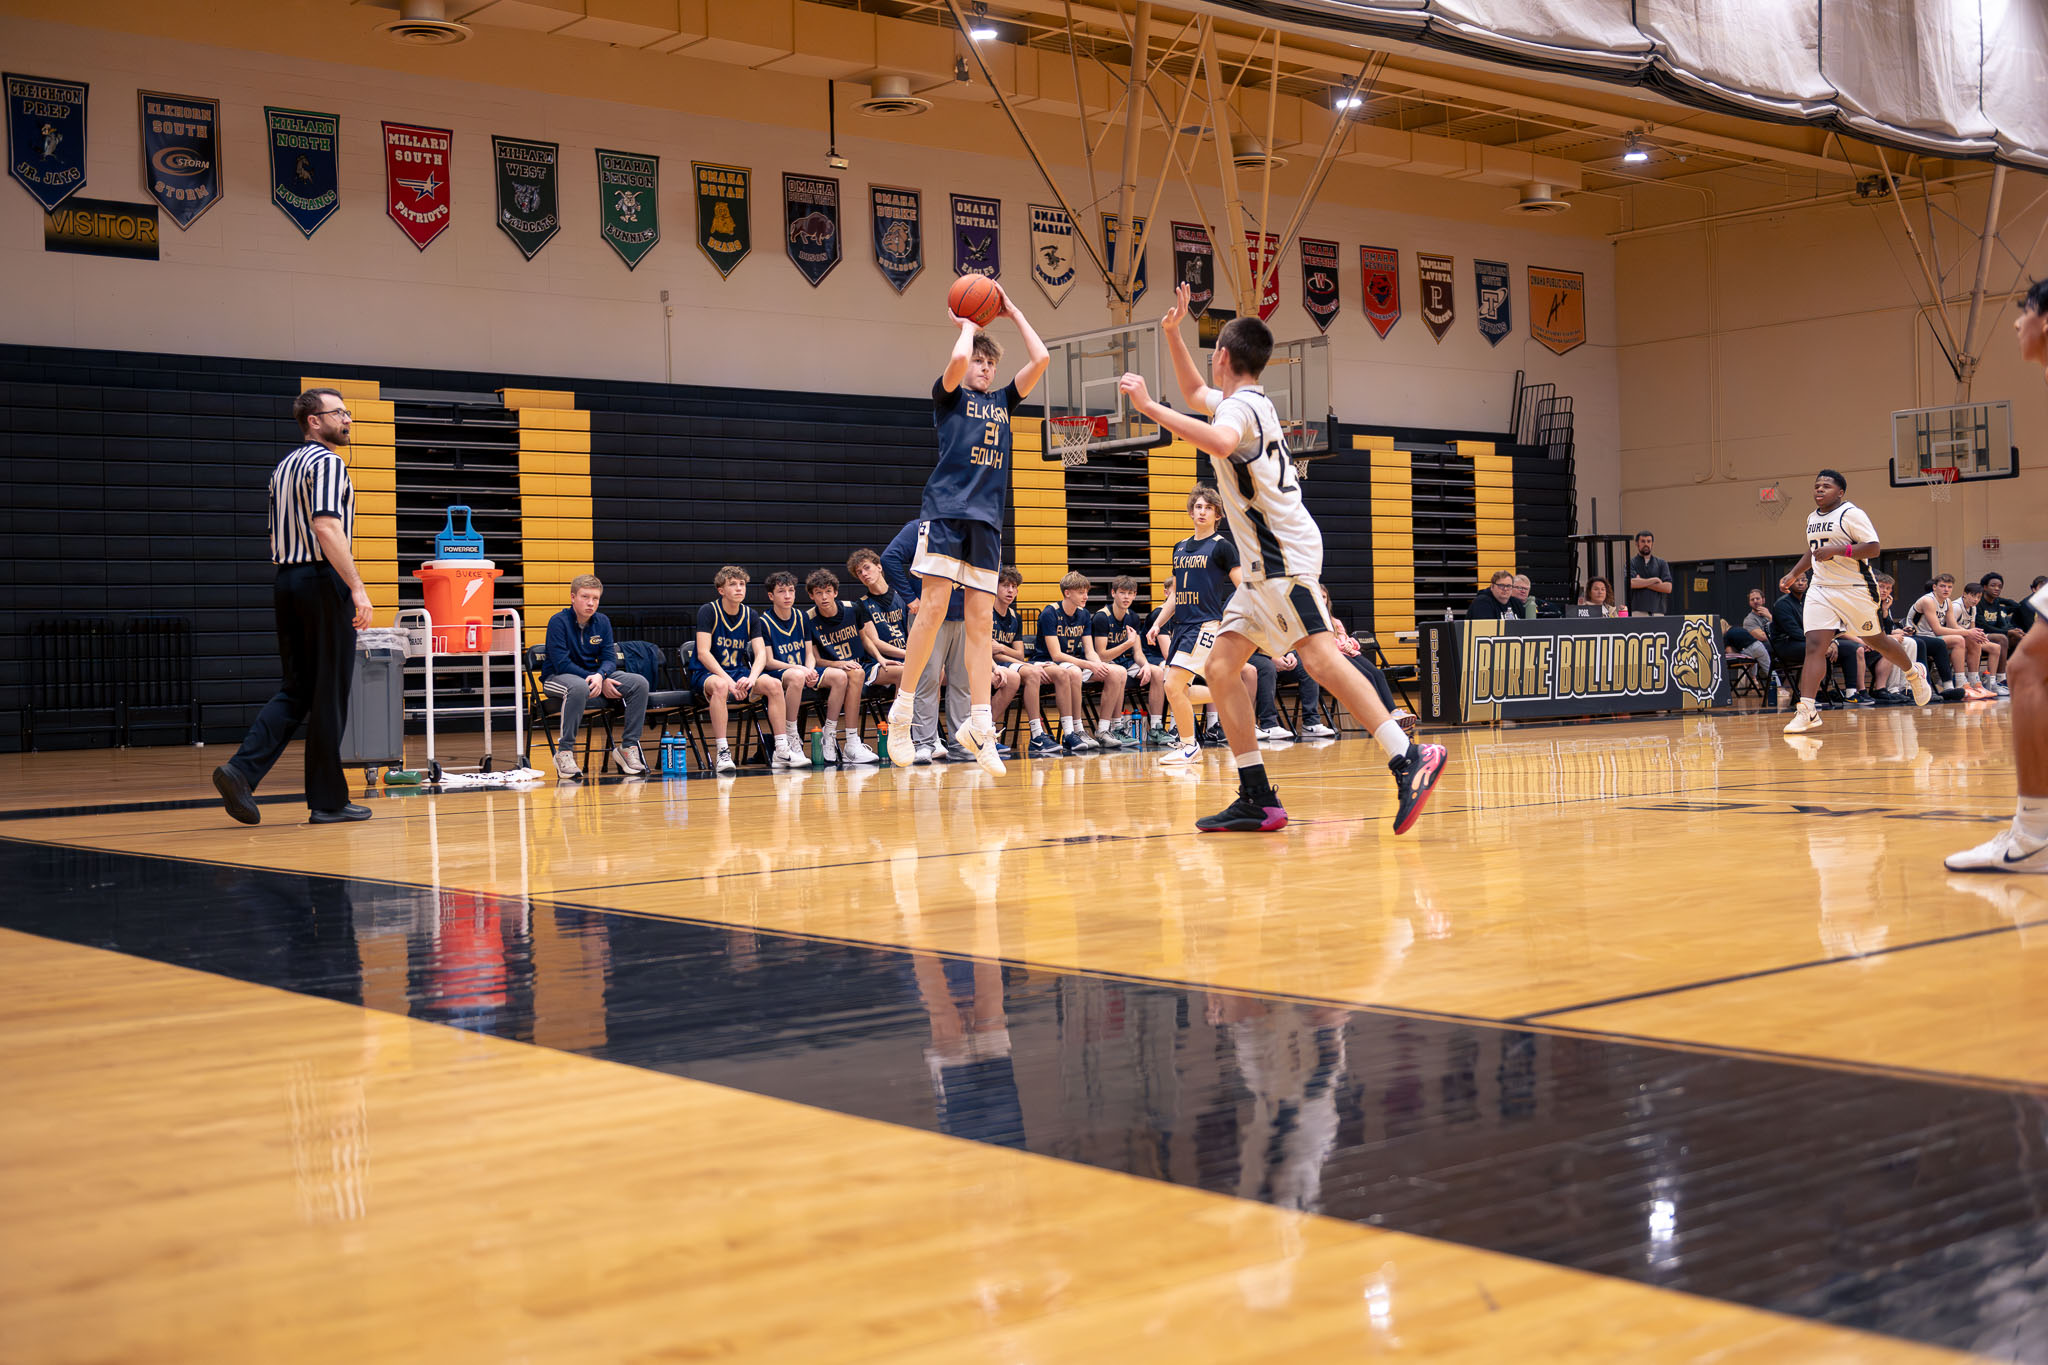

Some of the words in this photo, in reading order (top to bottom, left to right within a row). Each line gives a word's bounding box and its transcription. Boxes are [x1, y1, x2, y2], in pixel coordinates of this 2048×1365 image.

[10, 81, 83, 104] CREIGHTON
[23, 100, 71, 119] PREP
[147, 102, 211, 121] ELKHORN
[152, 120, 208, 138] SOUTH
[271, 116, 335, 135] MILLARD
[276, 133, 331, 151] NORTH
[388, 132, 448, 150] MILLARD
[177, 157, 210, 169] STORM
[395, 149, 443, 165] SOUTH
[498, 145, 554, 164] MILLARD
[16, 161, 41, 183] JR.
[43, 166, 81, 185] JAYS
[506, 162, 547, 179] WEST
[604, 158, 651, 173] OMAHA
[602, 171, 655, 188] BENSON
[700, 170, 745, 186] OMAHA
[154, 181, 209, 200] STORM
[700, 183, 745, 199] BRYAN
[787, 179, 835, 196] OMAHA
[275, 183, 337, 210] MUSTANGS
[875, 192, 917, 208] OMAHA
[394, 200, 449, 223] PATRIOTS
[876, 205, 917, 220] BURKE
[956, 202, 995, 216] OMAHA
[1034, 210, 1071, 224] OMAHA
[51, 209, 157, 241] VISITOR
[502, 208, 557, 233] WILDCATS
[955, 215, 999, 229] CENTRAL
[1033, 222, 1072, 236] MARIAN
[605, 223, 656, 244] BUNNIES
[707, 236, 743, 253] BEARS
[1304, 244, 1335, 257] OMAHA
[798, 250, 828, 262] BISON
[1364, 251, 1395, 263] OMAHA
[1314, 272, 1327, 289] W
[1807, 521, 1834, 534] BURKE
[820, 624, 858, 646] ELKHORN
[1200, 631, 1215, 649] ES
[833, 642, 853, 660] 30
[1066, 639, 1075, 653] 5
[722, 649, 739, 667] 24
[1430, 629, 1440, 717] BULLDOGS
[1474, 637, 1553, 702] BURKE
[1556, 632, 1668, 699] BULLDOGS
